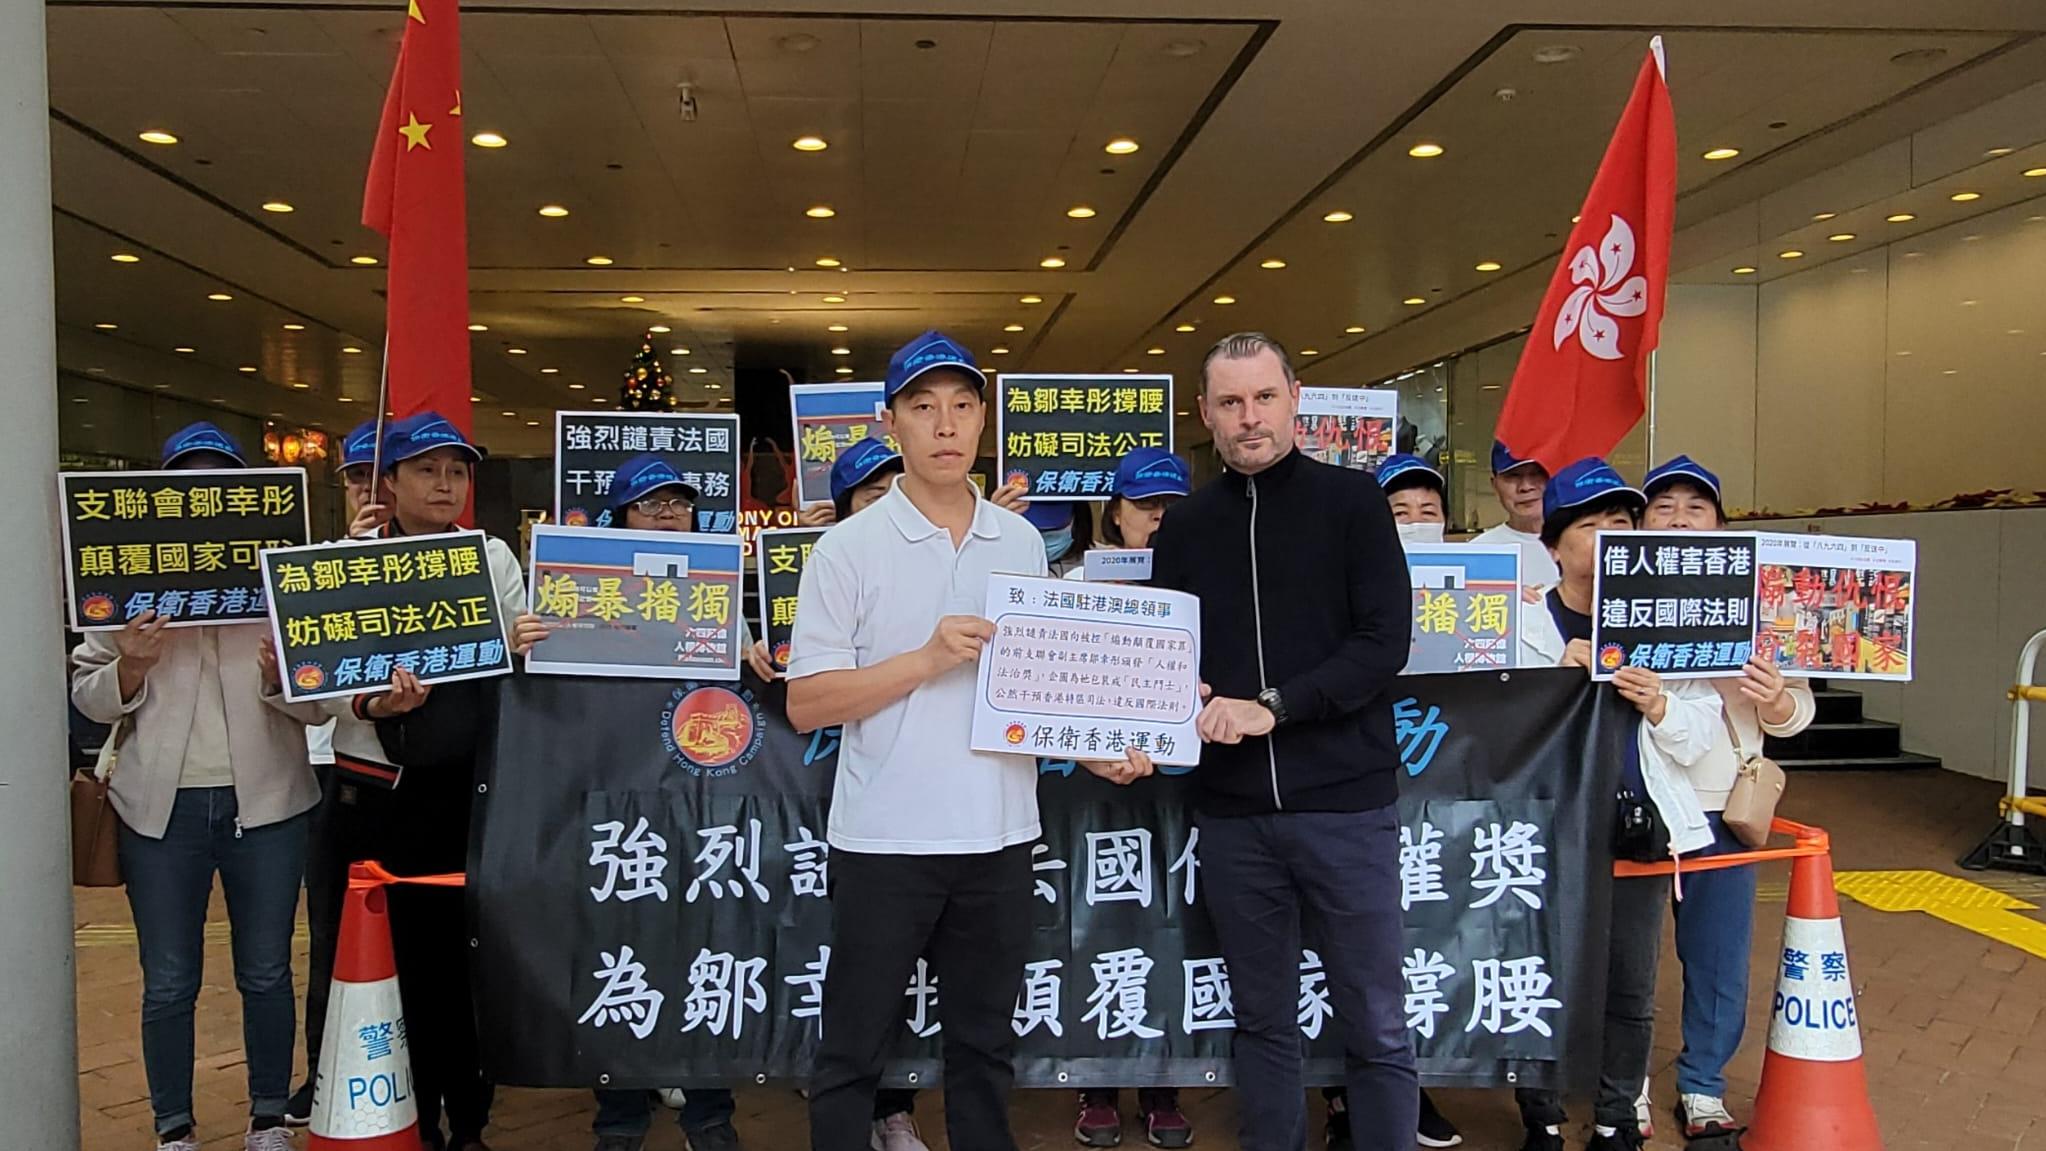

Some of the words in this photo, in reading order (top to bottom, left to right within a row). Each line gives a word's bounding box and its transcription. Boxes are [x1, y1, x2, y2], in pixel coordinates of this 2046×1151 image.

[1007, 387, 1164, 413] 為鄒幸彤撐腰
[566, 424, 730, 453] 強烈譴責法國
[74, 485, 296, 520] 支聯會鄒幸彤
[79, 538, 294, 577] 顛覆國家可
[276, 546, 481, 593] 為鄒幸彤撐腰
[1603, 546, 1751, 576] 借人權害香港
[535, 574, 730, 625] 煽暴播獨
[1416, 591, 1508, 635] 播獨
[1602, 597, 1749, 628] 違反國際法則
[286, 596, 492, 647] 妨礙司法公正
[334, 638, 504, 687] 保衛香港運動
[1629, 641, 1751, 669] 保衛香港運動
[660, 711, 676, 752] Defend
[672, 753, 702, 777] Hong
[706, 765, 738, 777] Kong
[738, 712, 767, 766] Campaign
[1031, 724, 1176, 756] 保衛香港運動
[1783, 947, 1846, 982] 警察
[1773, 991, 1855, 1029] POLICE
